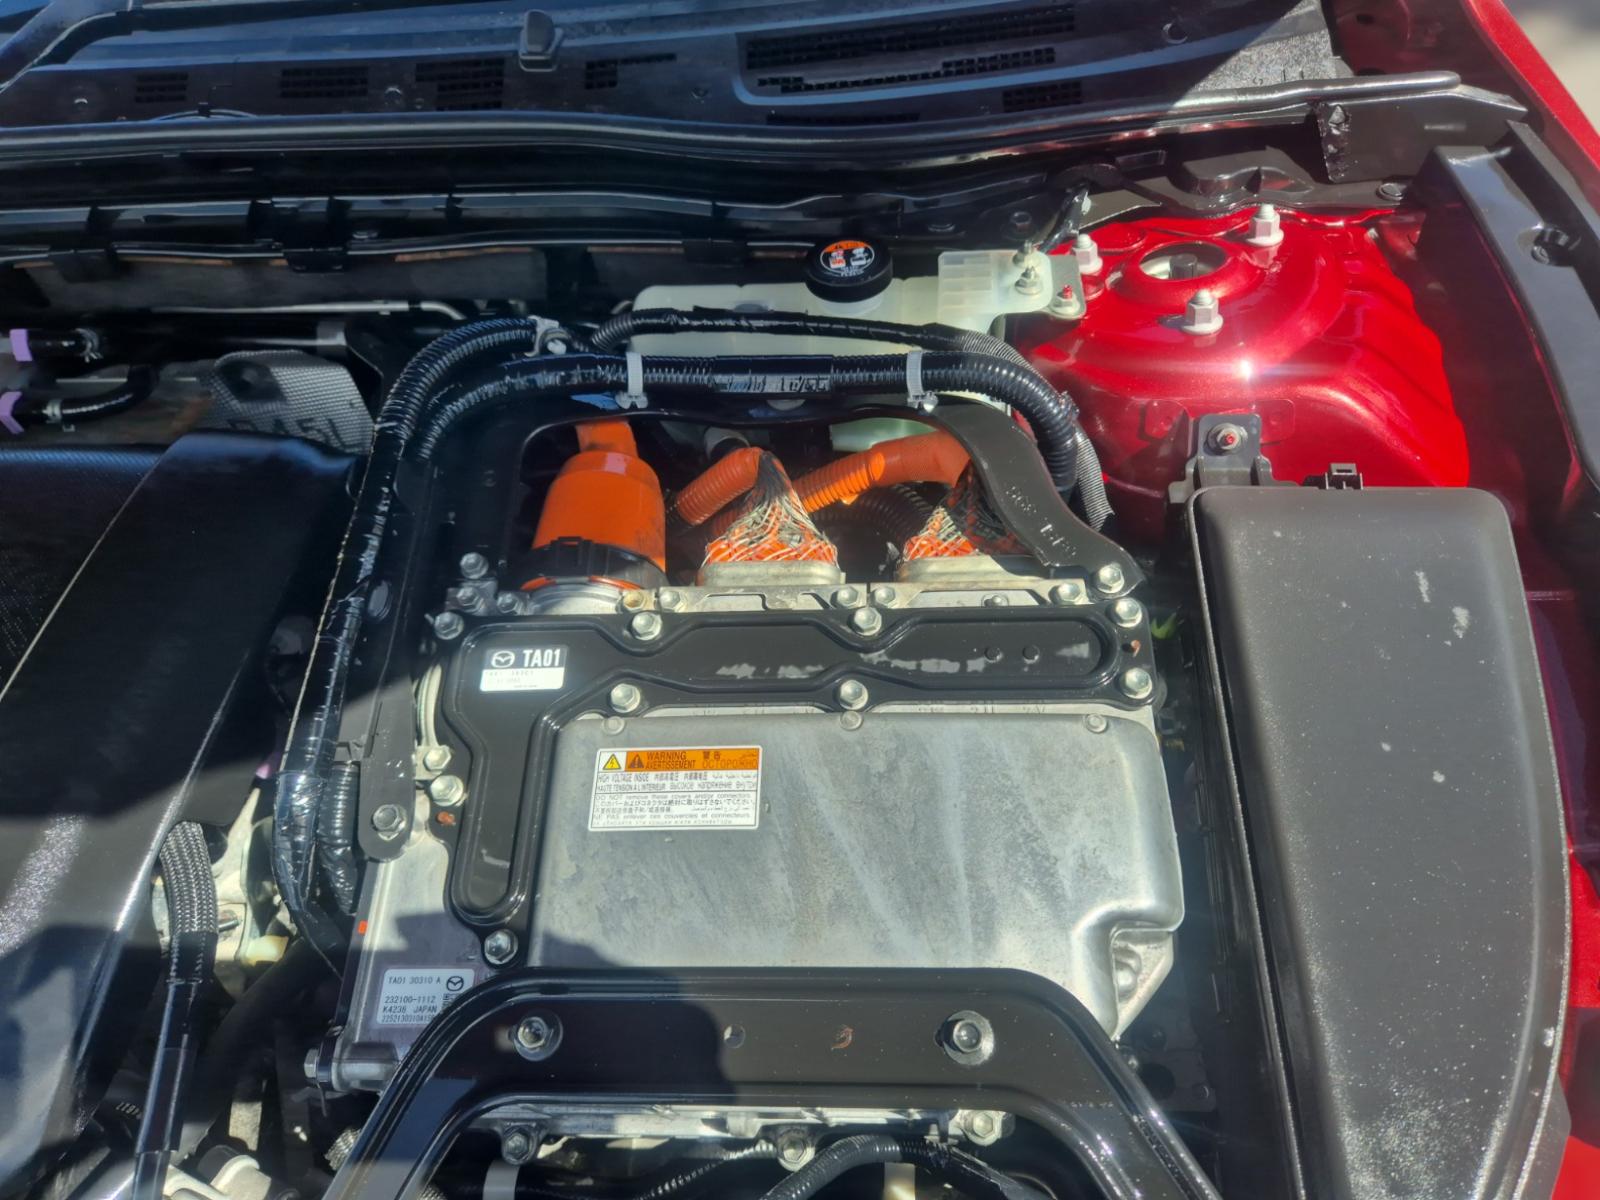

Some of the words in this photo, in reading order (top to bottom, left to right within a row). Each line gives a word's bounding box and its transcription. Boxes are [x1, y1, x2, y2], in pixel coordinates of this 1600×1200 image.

[523, 648, 560, 667] TA01
[647, 751, 687, 760] WARNING
[645, 760, 696, 770] AVERTISSEMENT
[409, 976, 433, 984] 30310
[436, 976, 441, 984] A
[413, 1005, 438, 1013] JAPAN
